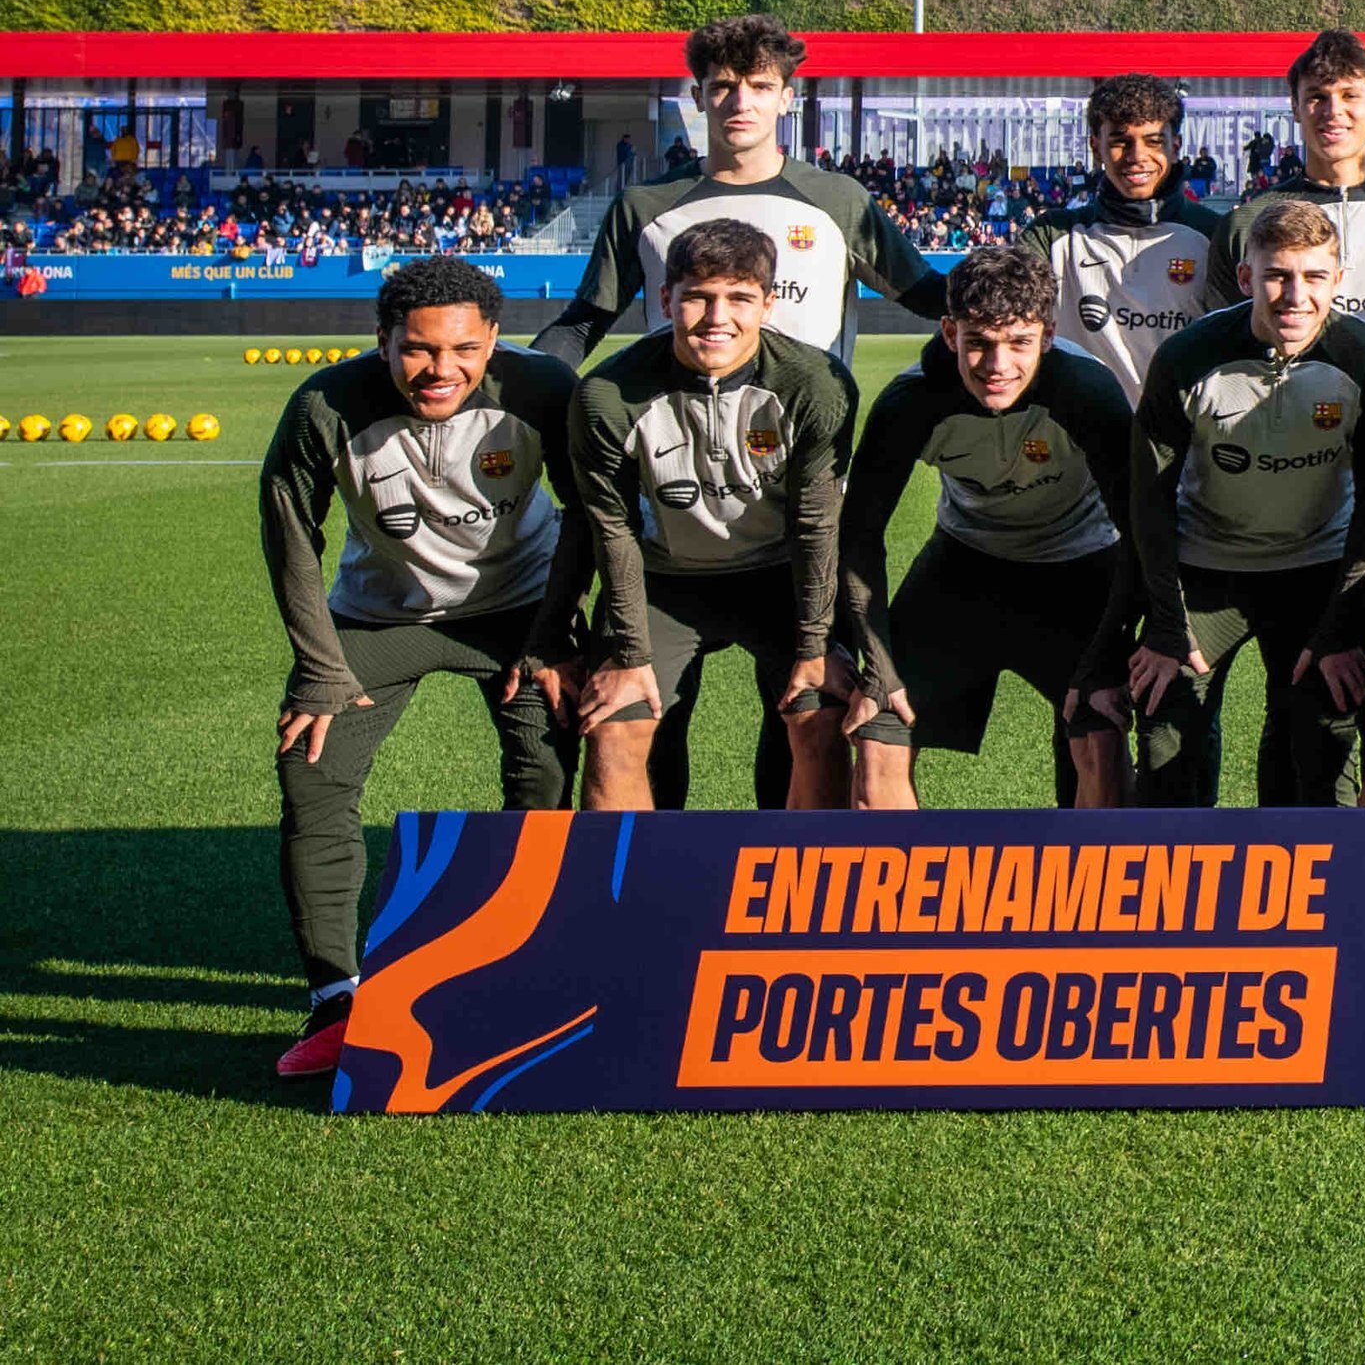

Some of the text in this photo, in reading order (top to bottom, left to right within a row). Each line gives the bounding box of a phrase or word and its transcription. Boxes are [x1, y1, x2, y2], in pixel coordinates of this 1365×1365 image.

[171, 263, 294, 280] MÉS QUE UN CLUB
[772, 280, 808, 303] tify
[1257, 445, 1343, 473] Spotify
[427, 496, 519, 527] Spotify
[725, 843, 1332, 933] ENTRENAMENT DE
[711, 969, 1308, 1063] PORTES OBERTES
